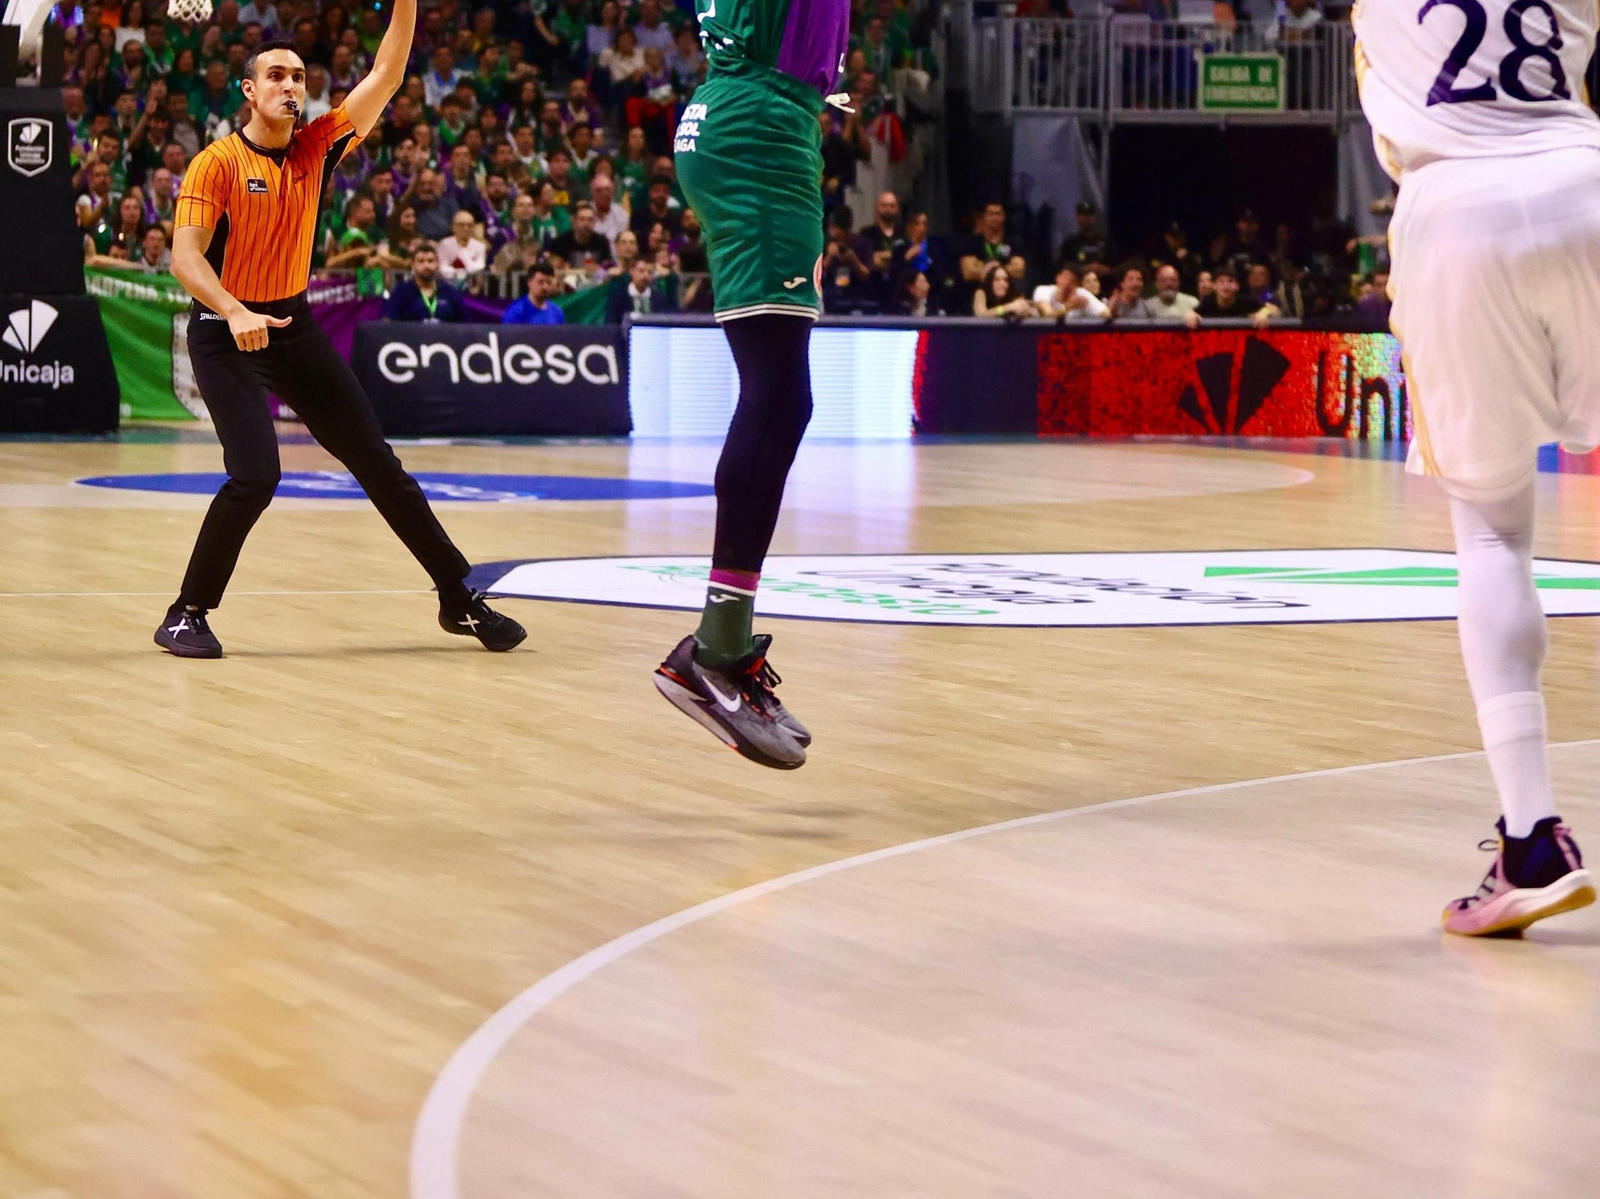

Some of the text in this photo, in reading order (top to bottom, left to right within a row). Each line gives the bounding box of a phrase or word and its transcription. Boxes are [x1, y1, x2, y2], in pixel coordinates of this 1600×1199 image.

[0, 358, 75, 390] nicaja
[378, 331, 619, 385] endesa
[797, 569, 1096, 605] Unicaja
